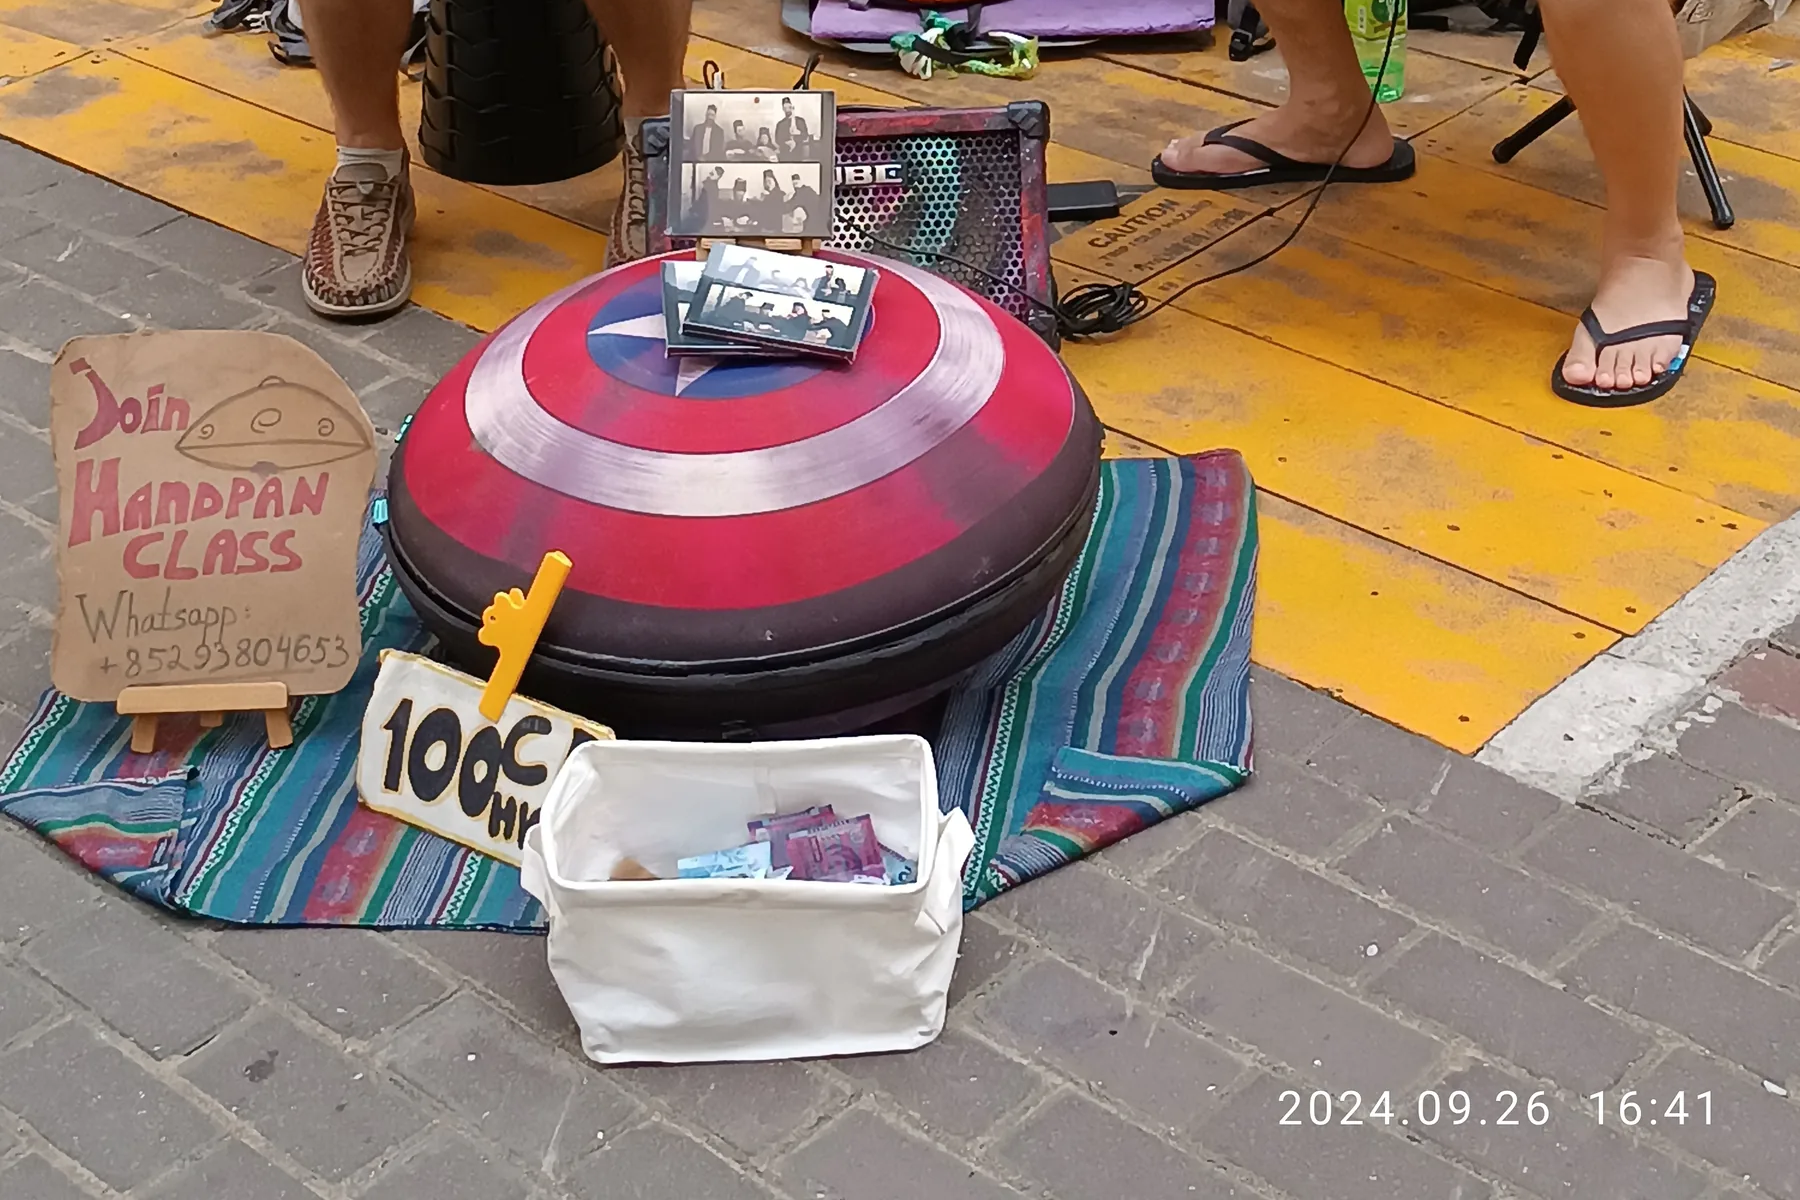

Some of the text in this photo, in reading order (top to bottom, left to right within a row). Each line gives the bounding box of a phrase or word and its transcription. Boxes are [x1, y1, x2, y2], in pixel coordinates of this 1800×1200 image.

[1088, 198, 1180, 248] CAUTION
[69, 357, 191, 450] Join
[122, 529, 303, 581] CLASS
[100, 635, 351, 678] +85293804653
